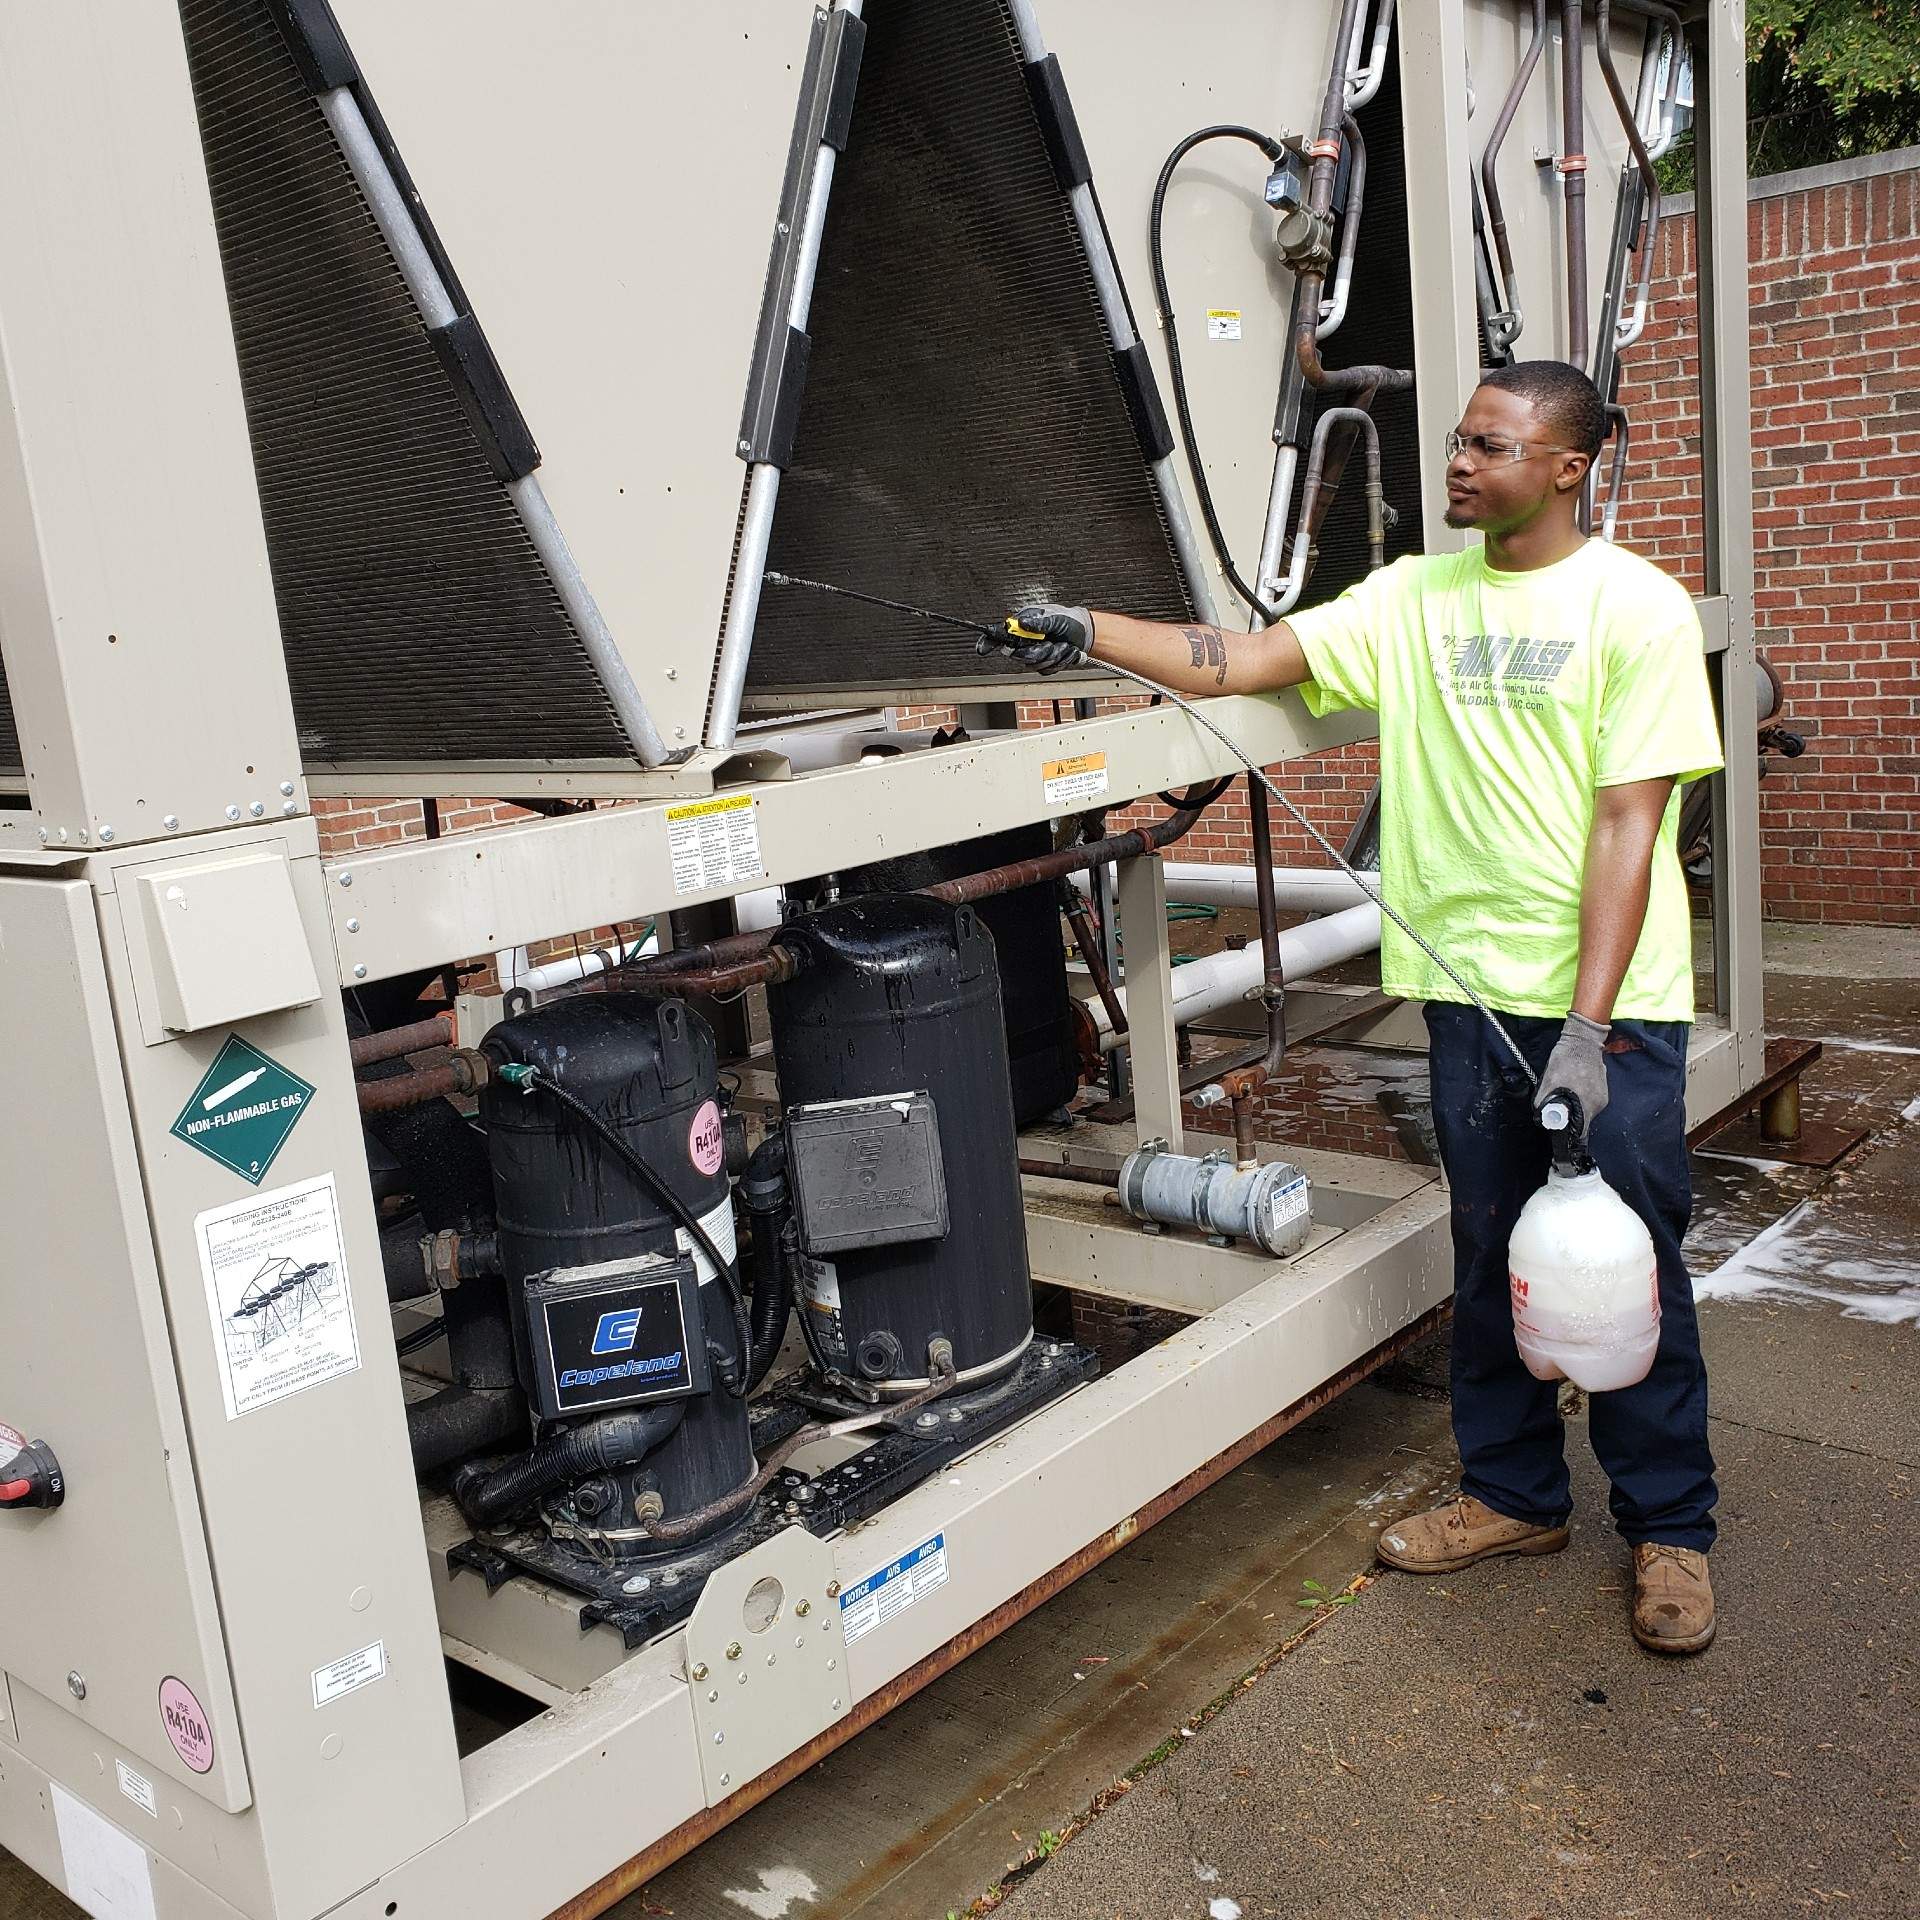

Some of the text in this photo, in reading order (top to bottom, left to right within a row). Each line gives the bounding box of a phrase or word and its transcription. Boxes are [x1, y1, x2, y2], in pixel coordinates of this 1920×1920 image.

[1502, 637, 1576, 682] DASH
[1530, 684, 1549, 695] LLC.
[674, 808, 695, 819] CAUTION
[187, 1092, 302, 1135] NON-FLAMMABLE GAS
[705, 1117, 714, 1130] USE
[695, 1123, 720, 1154] R410A
[706, 1145, 718, 1159] ONLY
[251, 1161, 259, 1172] 2
[231, 1211, 260, 1226] RIGGING
[560, 1352, 681, 1388] Copeland
[50, 1478, 62, 1492] ON
[918, 1541, 937, 1560] AVISO
[886, 1563, 901, 1580] AVIS
[845, 1581, 870, 1606] NOTICE
[175, 1699, 191, 1716] USE
[165, 1705, 207, 1746] R410A
[180, 1735, 198, 1751] ONLY
